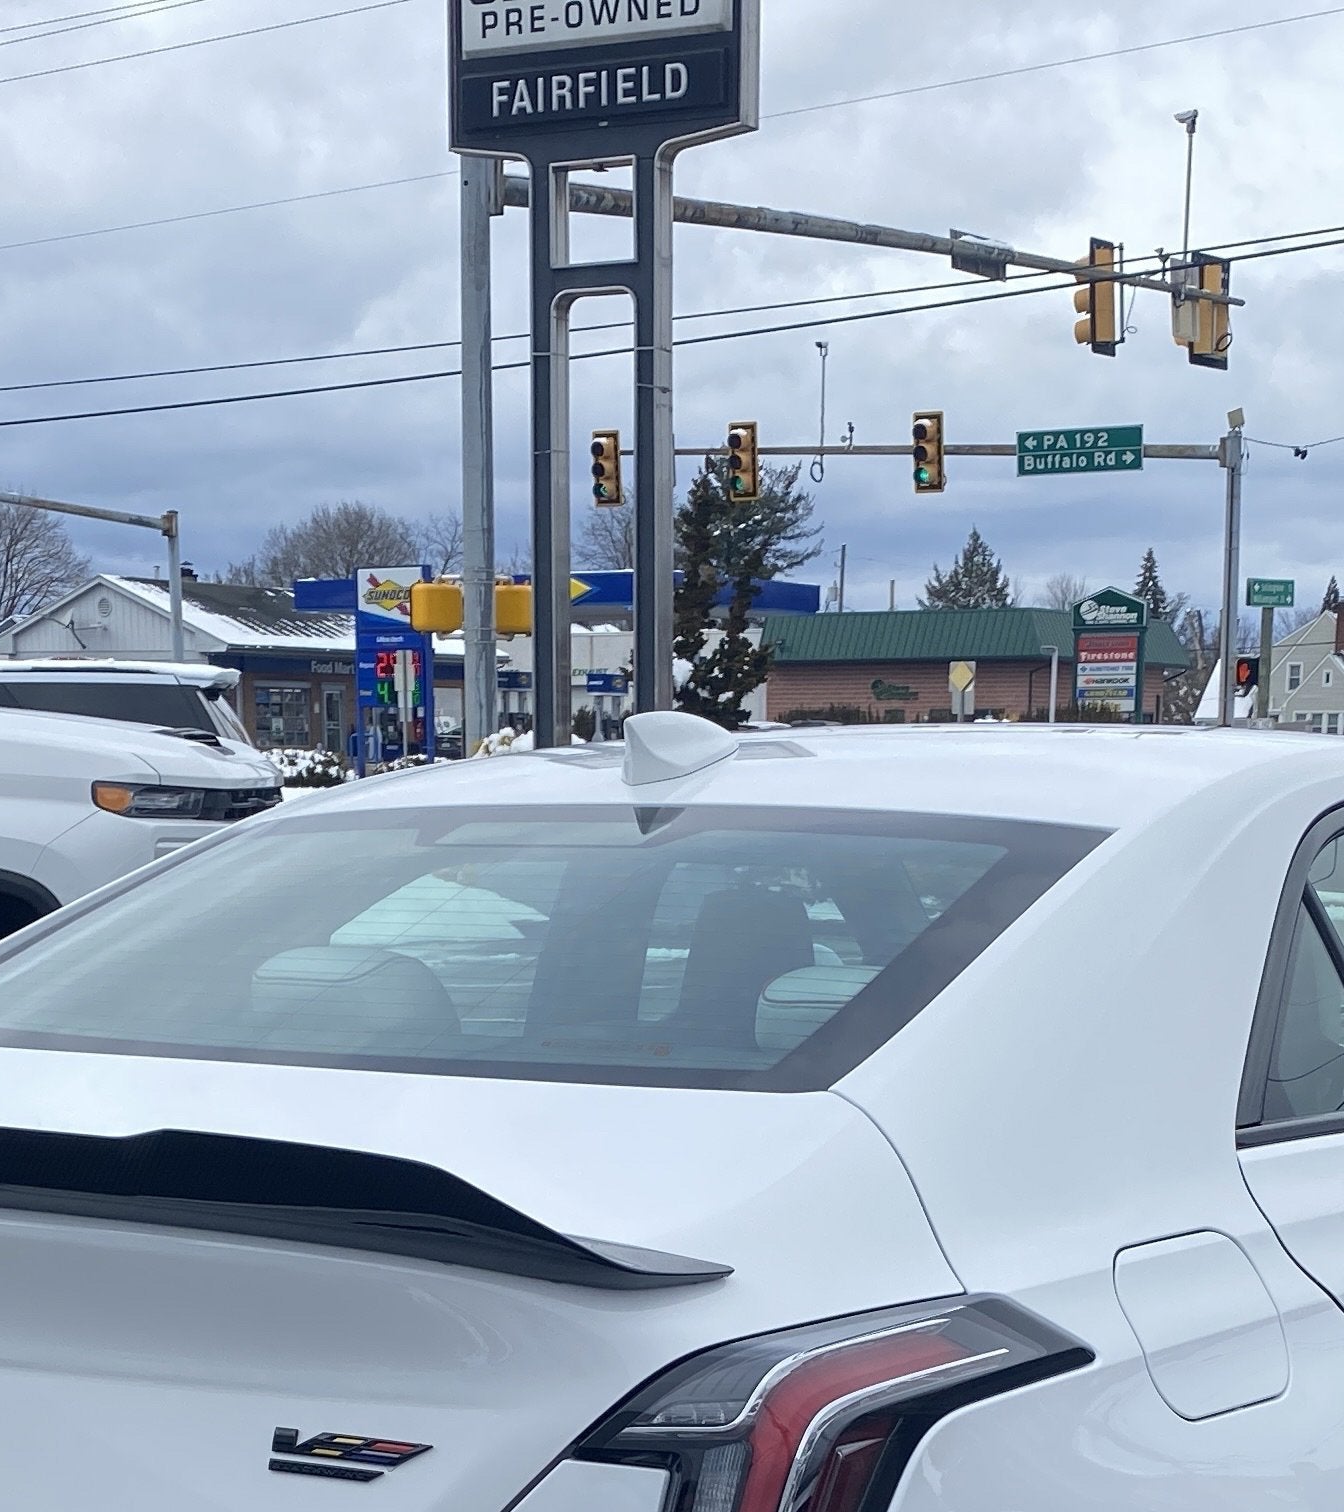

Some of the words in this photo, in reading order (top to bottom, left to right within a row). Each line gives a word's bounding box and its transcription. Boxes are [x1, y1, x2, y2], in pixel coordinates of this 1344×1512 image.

[481, 0, 700, 38] PRE-OWNED
[491, 62, 689, 118] FAIRFIELD
[1043, 434, 1068, 450] PA
[1074, 431, 1108, 448] 192
[1023, 453, 1088, 470] Buffalo
[1094, 451, 1116, 467] Rd
[366, 589, 411, 601] SUNOCO
[1080, 651, 1135, 662] Firestone
[311, 660, 333, 673] Food
